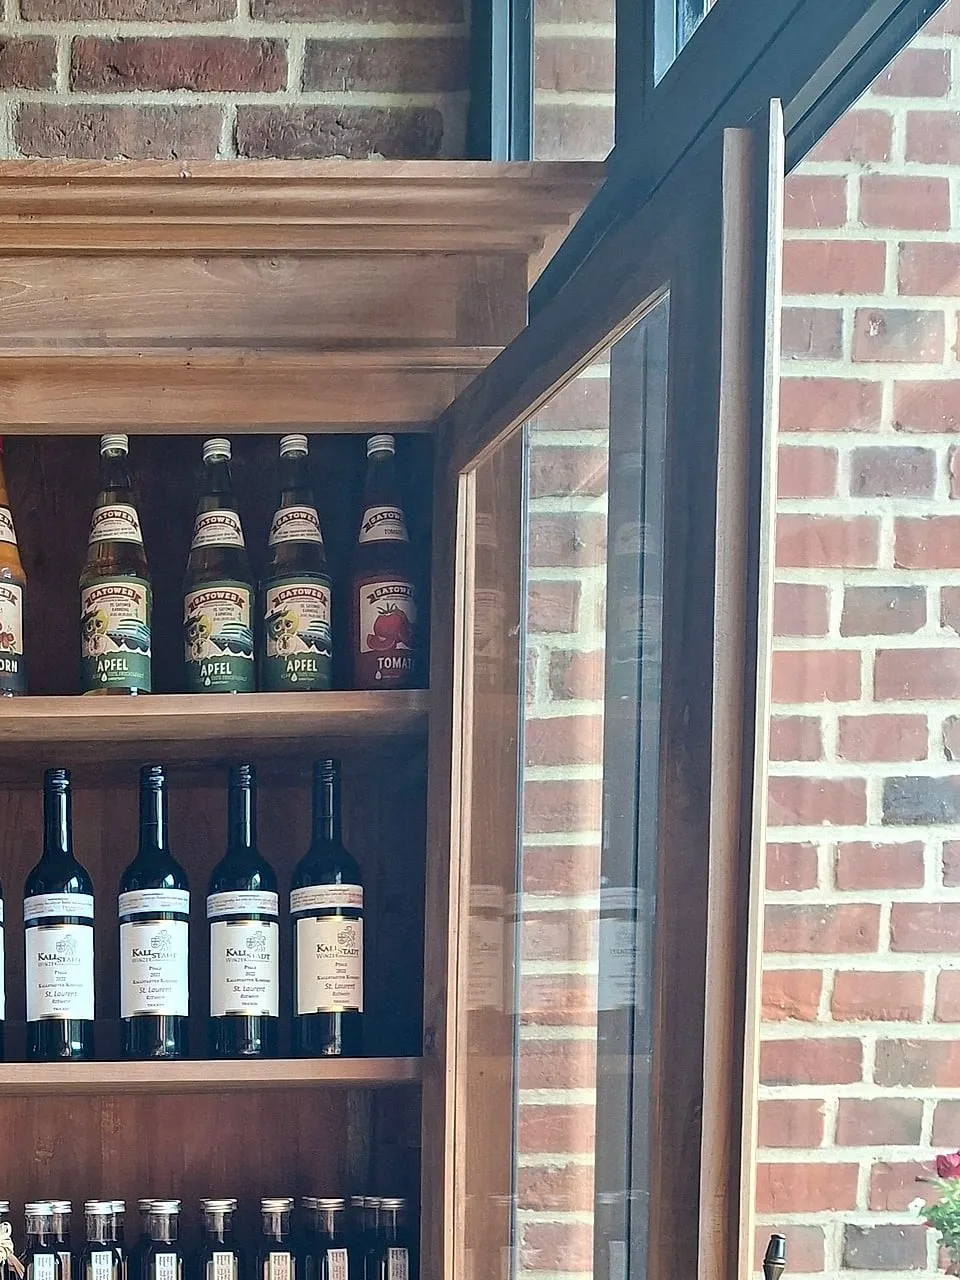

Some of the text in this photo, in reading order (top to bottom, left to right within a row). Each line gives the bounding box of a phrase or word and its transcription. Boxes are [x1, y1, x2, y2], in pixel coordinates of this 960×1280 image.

[90, 587, 134, 600] SATOWER
[194, 592, 237, 605] SATOWER
[280, 588, 322, 600] SATOWER
[97, 658, 129, 673] APFEL
[200, 662, 232, 677] APFEL
[286, 659, 318, 673] APFEL
[377, 657, 414, 669] TOMAT
[316, 944, 359, 956] KALLSTADT
